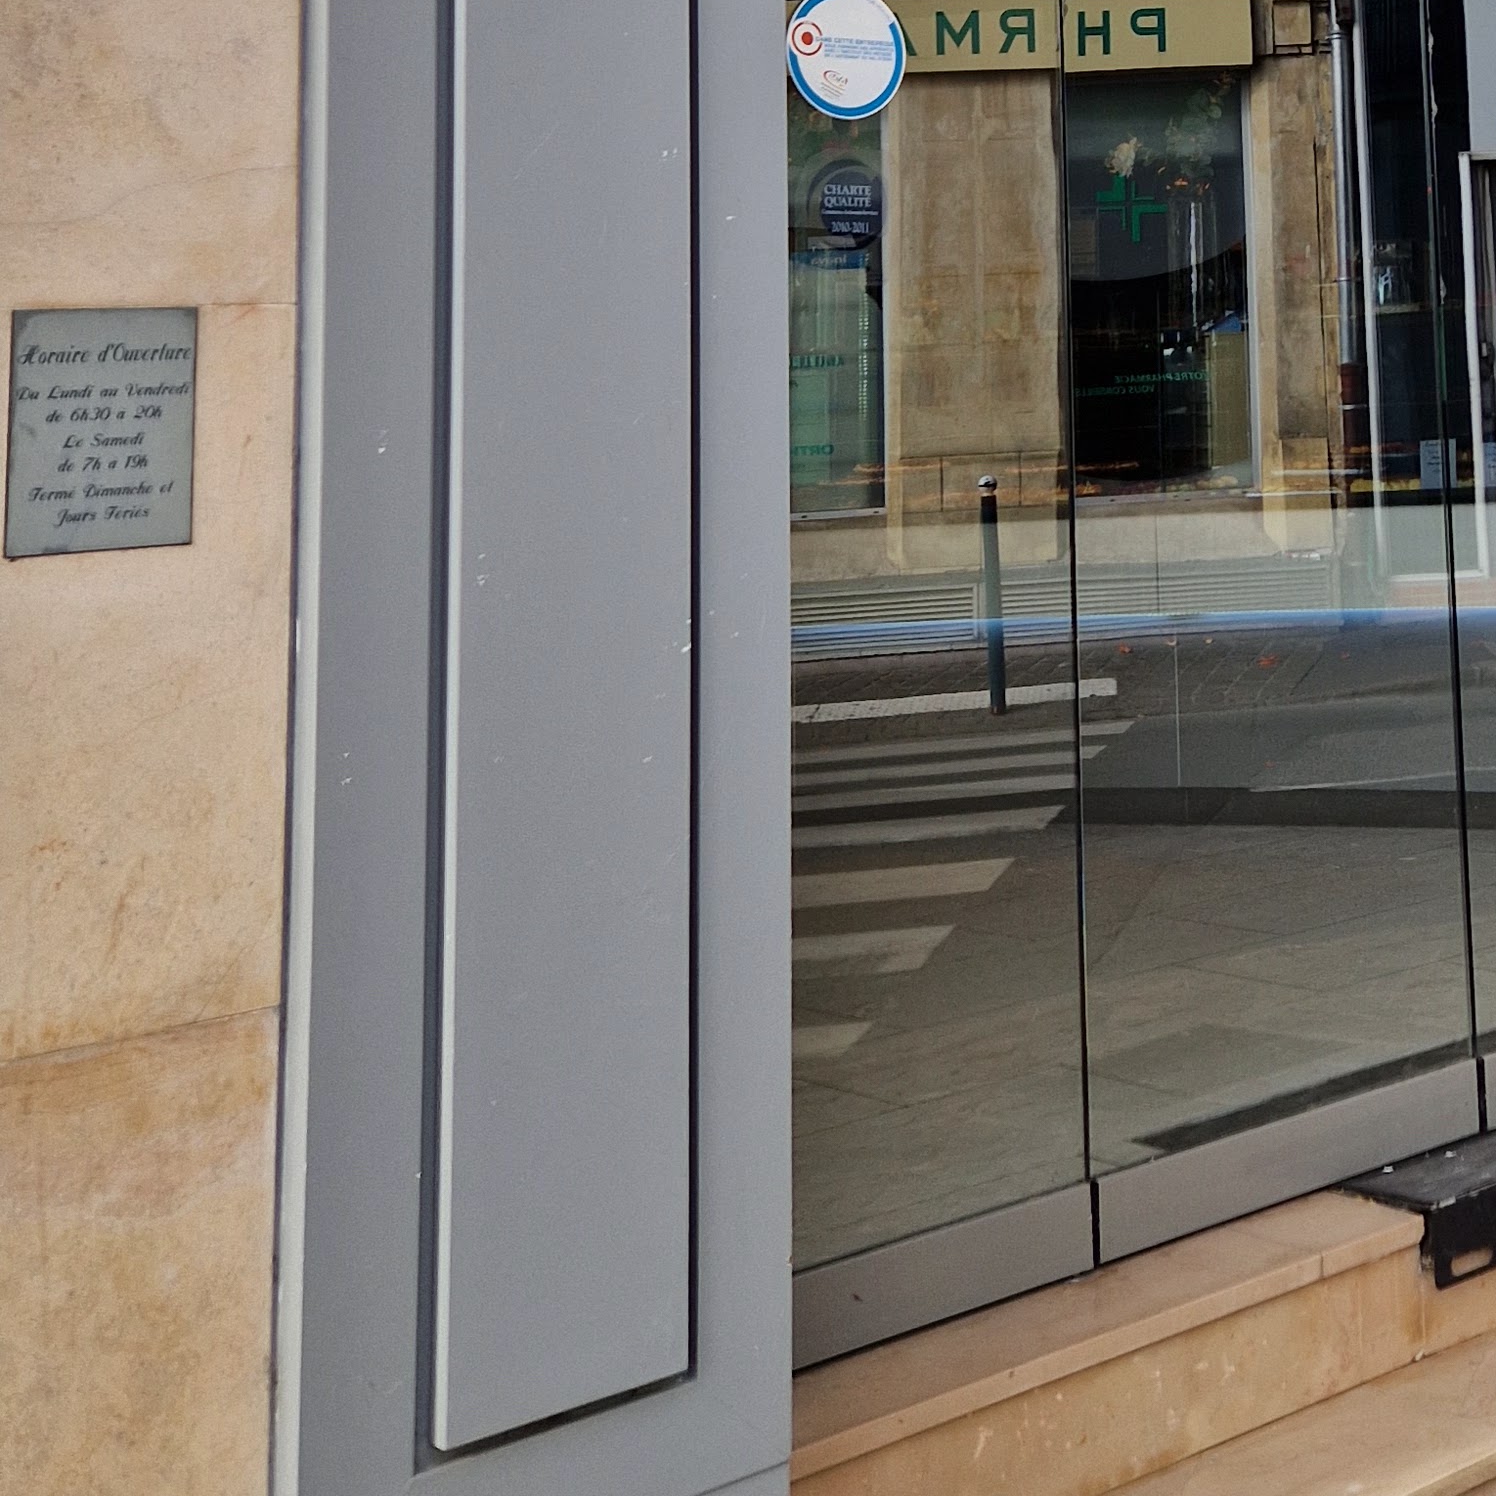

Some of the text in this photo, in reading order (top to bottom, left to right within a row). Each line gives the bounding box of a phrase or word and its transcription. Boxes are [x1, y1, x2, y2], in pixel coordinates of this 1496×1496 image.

[823, 184, 872, 197] CHARTE
[17, 342, 192, 365] Horaire d'Ouverture
[17, 381, 192, 400] Du Lundi au Vendredi
[45, 409, 61, 423] de
[70, 406, 111, 421] 6h30
[134, 405, 163, 420] 20h
[62, 432, 145, 449] Le Samedi
[57, 458, 74, 473] de
[82, 456, 101, 472] 7h
[124, 454, 149, 470] 19h
[83, 481, 153, 499] Dimanche
[159, 480, 175, 494] et
[53, 507, 97, 528] Jours
